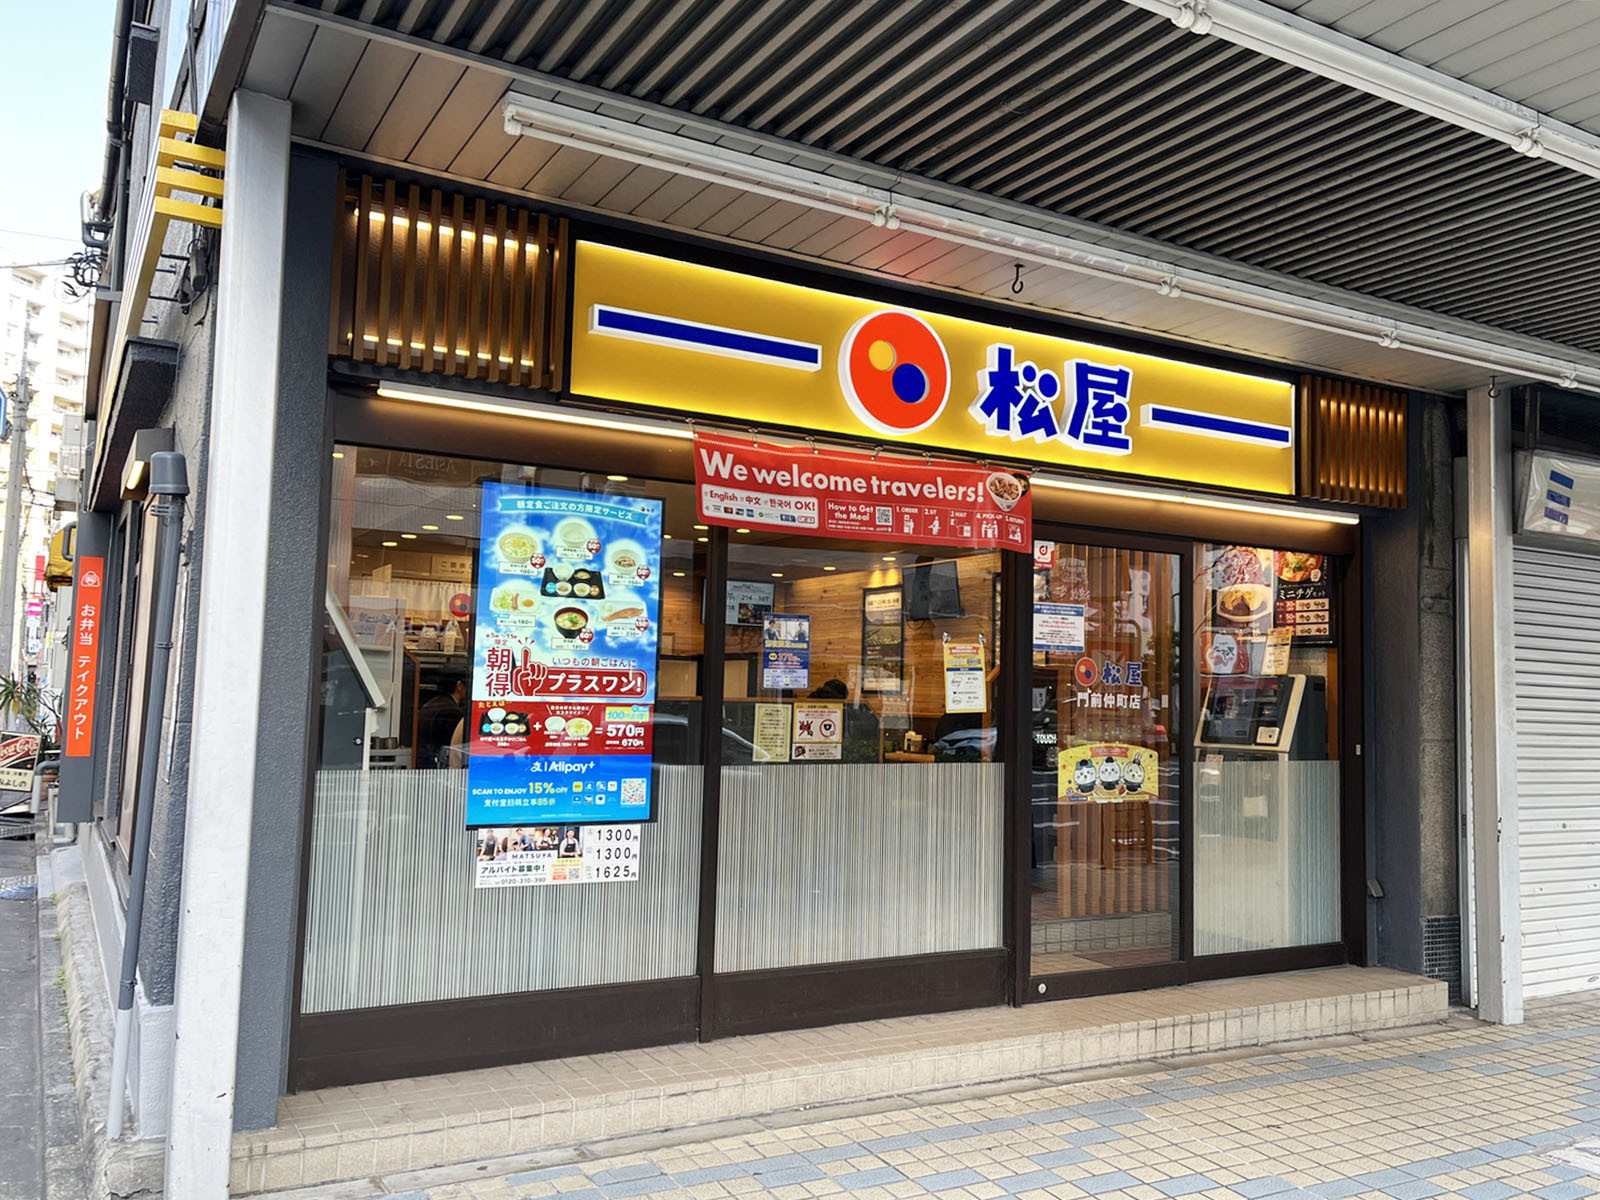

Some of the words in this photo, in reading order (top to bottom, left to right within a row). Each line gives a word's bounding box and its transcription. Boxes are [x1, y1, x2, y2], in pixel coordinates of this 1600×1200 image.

[970, 343, 1132, 455] 松屋
[700, 448, 748, 482] We
[751, 464, 868, 494] welcome
[871, 476, 985, 503] travelers!
[709, 490, 738, 503] English
[745, 496, 761, 506] 中文
[769, 498, 791, 509] 한국어
[794, 500, 815, 511] OK!
[828, 502, 846, 511] How
[848, 504, 857, 512] to
[859, 504, 874, 513] Get
[834, 511, 848, 519] the
[849, 512, 870, 521] Meal
[79, 604, 95, 646] お弁当
[552, 657, 637, 668] いつもの朝ごはんに
[486, 647, 511, 697] 朝得
[1101, 661, 1144, 687] 松屋
[547, 672, 642, 692] プラスワン!
[73, 655, 91, 740] テイクアウト
[1077, 691, 1141, 710] 門前仲町店
[606, 724, 645, 737] 570円
[621, 739, 644, 747] 670円
[528, 782, 555, 794] 15%
[511, 852, 553, 860] MATSUYA
[481, 864, 546, 874] アルバイト募集中!
[501, 877, 546, 886] 0120-310-390
